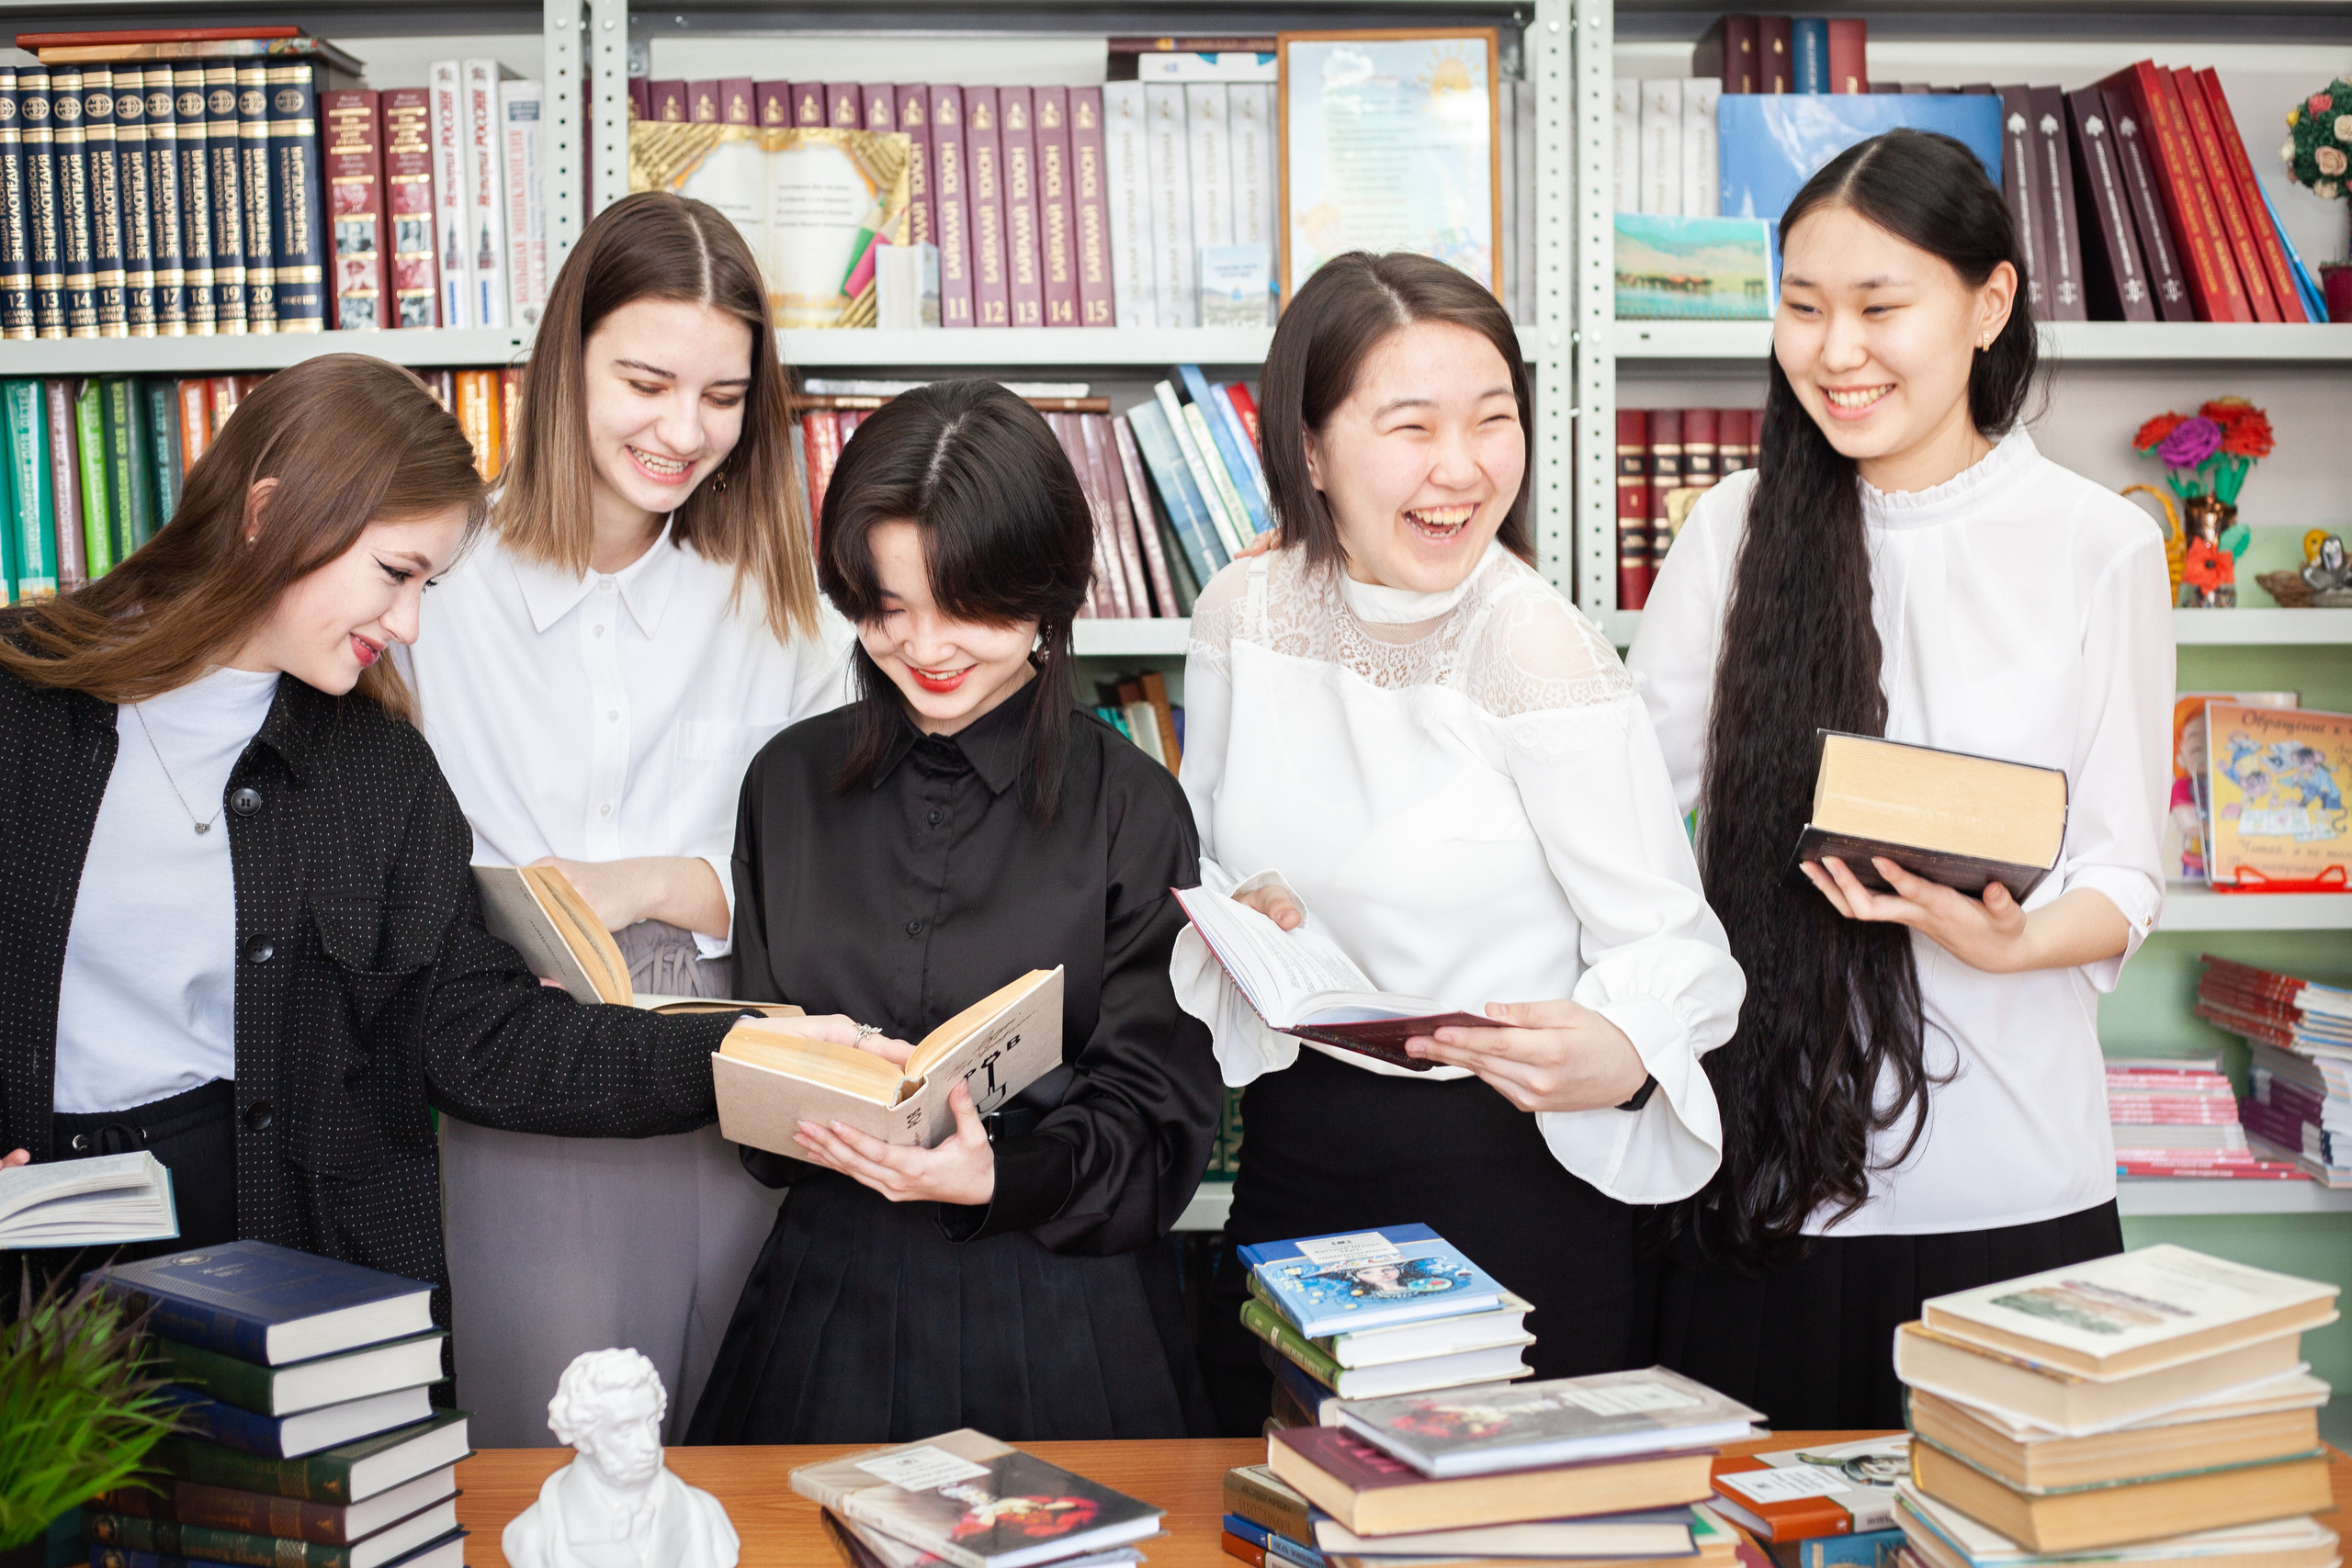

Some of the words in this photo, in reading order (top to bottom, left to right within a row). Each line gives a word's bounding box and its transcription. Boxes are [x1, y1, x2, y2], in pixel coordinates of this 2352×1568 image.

[941, 142, 957, 195] ТОЛОН
[978, 147, 994, 200] ТОЛОН
[1012, 147, 1028, 200] ТОЛОН
[1046, 146, 1062, 197] ТОЛОН
[1081, 146, 1097, 198] ТОЛОН
[28, 155, 40, 216] РОССИЙСКАЯ
[5, 154, 25, 263] ЭНЦИКЛОПЕДИЯ
[38, 154, 57, 263] ЭНЦИКЛОПЕДИЯ
[70, 154, 89, 263] ЭНЦИКЛОПЕДИЯ
[101, 151, 119, 259] ЭНЦИКЛОПЕДИЯ
[131, 152, 150, 260] ЭНЦИКЛОПЕДИЯ
[161, 150, 179, 258] ЭНЦИКЛОПЕДИЯ
[33, 218, 43, 263] БОЛЬШАЯ
[7, 292, 27, 309] 12
[40, 292, 60, 309] 13
[72, 292, 93, 309] 14
[102, 288, 121, 305] 15
[132, 289, 152, 307] 16
[162, 287, 181, 304] 17
[191, 287, 209, 304] 18
[222, 285, 241, 302] 19
[252, 286, 273, 304] 20
[98, 304, 126, 313] КОНГО
[948, 298, 967, 320] 11
[984, 300, 1004, 323] 12
[1018, 300, 1038, 323] 13
[1052, 299, 1072, 322] 14
[1088, 300, 1108, 322] 15
[16, 387, 30, 430] ДЕТЕЙ
[86, 387, 99, 429] ДЕТЕЙ
[110, 382, 125, 424] ДЕТЕЙ
[153, 390, 167, 433] ДЕТЕЙ
[20, 433, 32, 460] ДЛЯ
[54, 434, 67, 462] ДЛЯ
[89, 433, 102, 458] ДЛЯ
[114, 427, 128, 456] ДЛЯ
[156, 435, 170, 463] ДЛЯ
[22, 464, 40, 570] ЭНЦИКЛОПЕДИЯ
[56, 465, 74, 571] ЭНЦИКЛОПЕДИЯ
[92, 462, 108, 569] ЭНЦИКЛОПЕДИЯ
[2242, 708, 2326, 734] Обращение
[1238, 1498, 1291, 1534] КОМЕДИИ
[1274, 1541, 1289, 1554] ЧУДО
